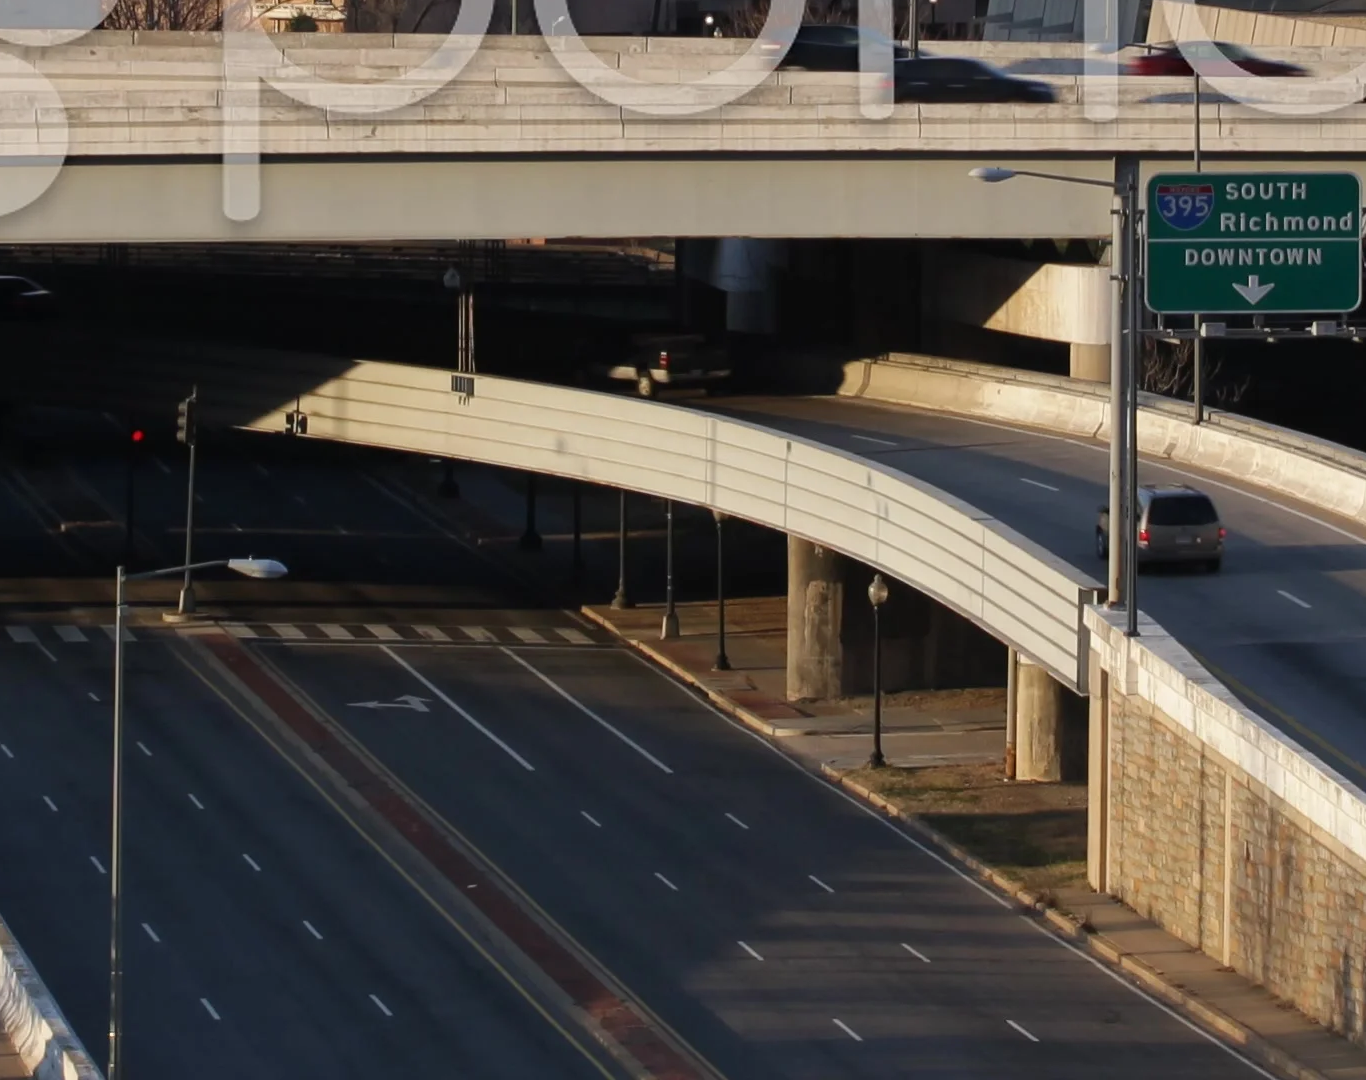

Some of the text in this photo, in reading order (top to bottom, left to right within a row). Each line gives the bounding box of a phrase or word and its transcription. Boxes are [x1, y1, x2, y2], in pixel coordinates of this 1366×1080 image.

[1225, 182, 1307, 200] SOUTH
[1162, 195, 1209, 217] 395
[1220, 211, 1353, 232] Richmond
[1185, 248, 1322, 266] DOWNTOWN
